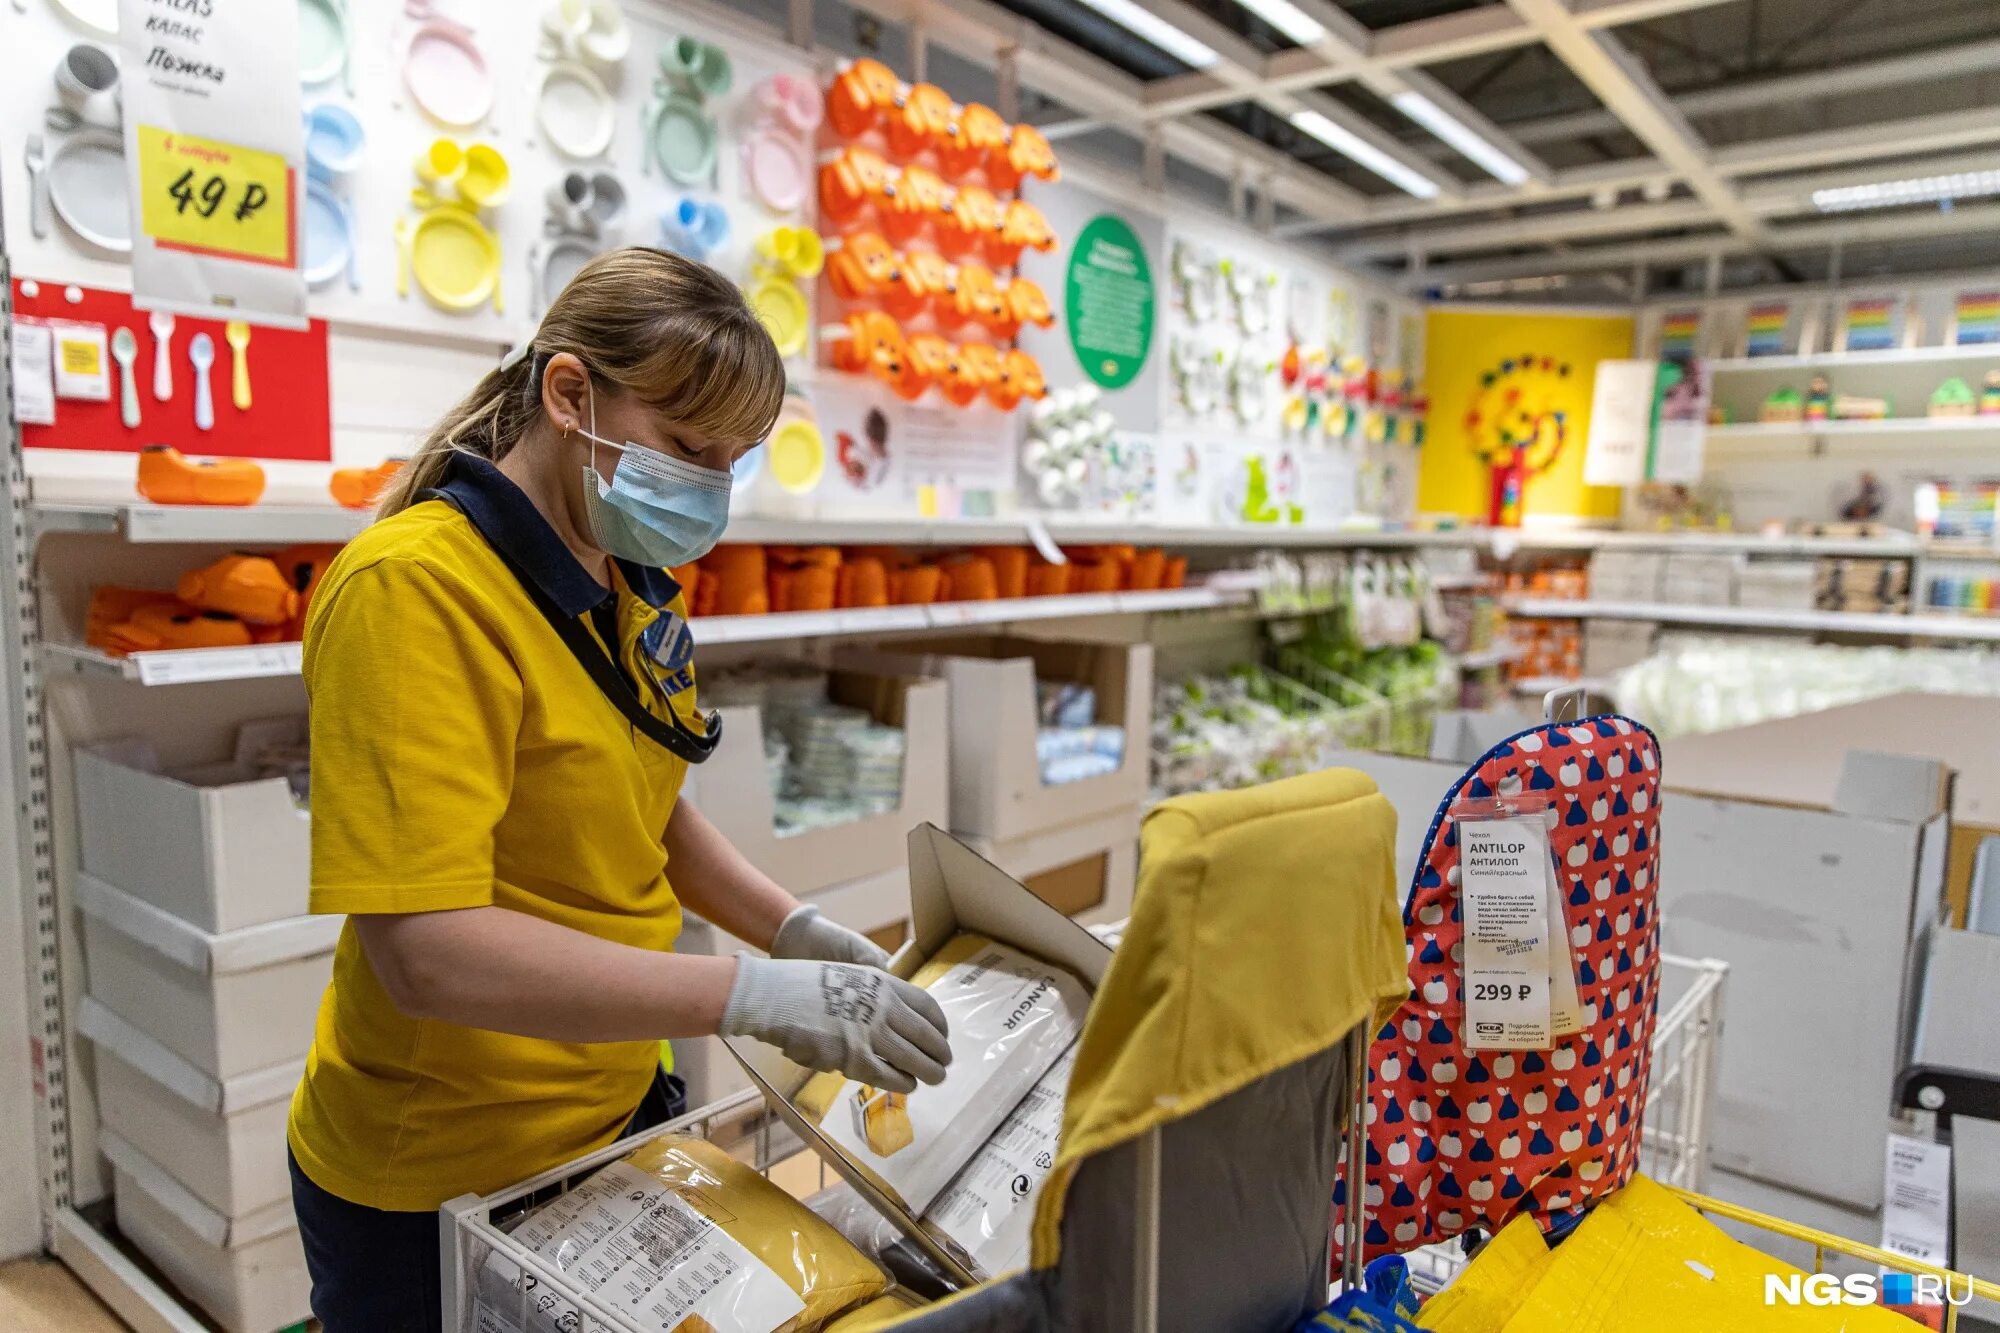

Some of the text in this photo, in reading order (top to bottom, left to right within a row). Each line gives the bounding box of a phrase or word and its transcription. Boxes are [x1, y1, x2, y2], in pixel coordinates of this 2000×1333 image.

[168, 168, 226, 218] 49
[1469, 843, 1526, 853] ANTILOP
[1469, 858, 1519, 866] АНТИЛОП
[1474, 984, 1531, 1001] 299 ₽
[1003, 975, 1056, 1029] LANGUR
[1477, 1024, 1502, 1032] IKEA
